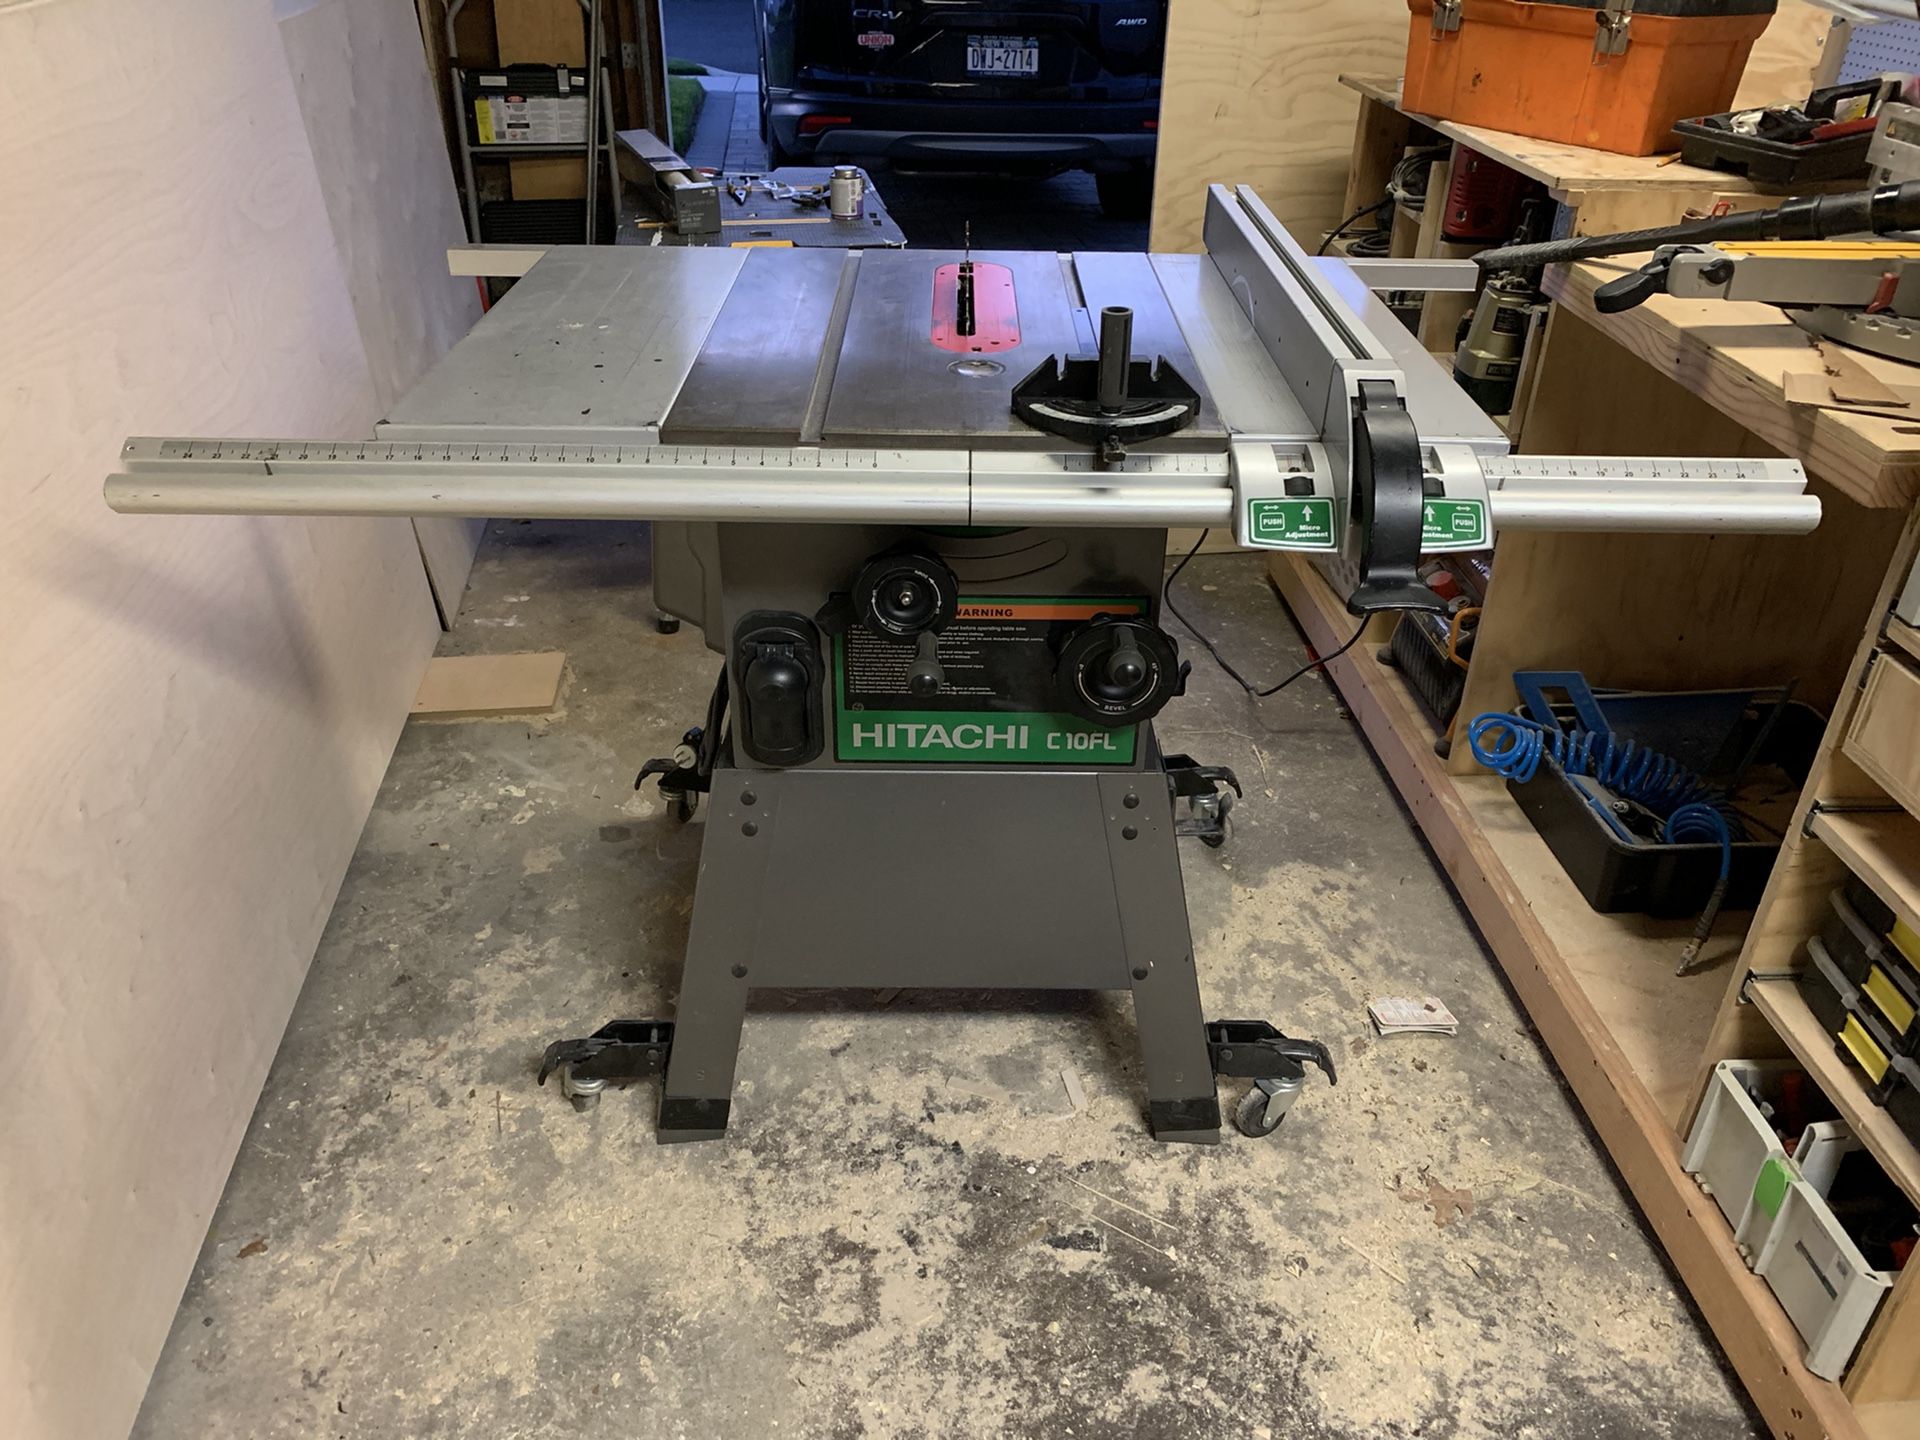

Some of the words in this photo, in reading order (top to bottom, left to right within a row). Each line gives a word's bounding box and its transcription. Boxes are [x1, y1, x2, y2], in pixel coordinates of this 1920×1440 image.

[853, 9, 903, 20] CR-V
[1115, 18, 1147, 26] AWD
[860, 35, 892, 45] UNION
[853, 723, 1029, 749] HITACHI
[1047, 732, 1060, 749] C
[1066, 732, 1117, 750] 10FL
